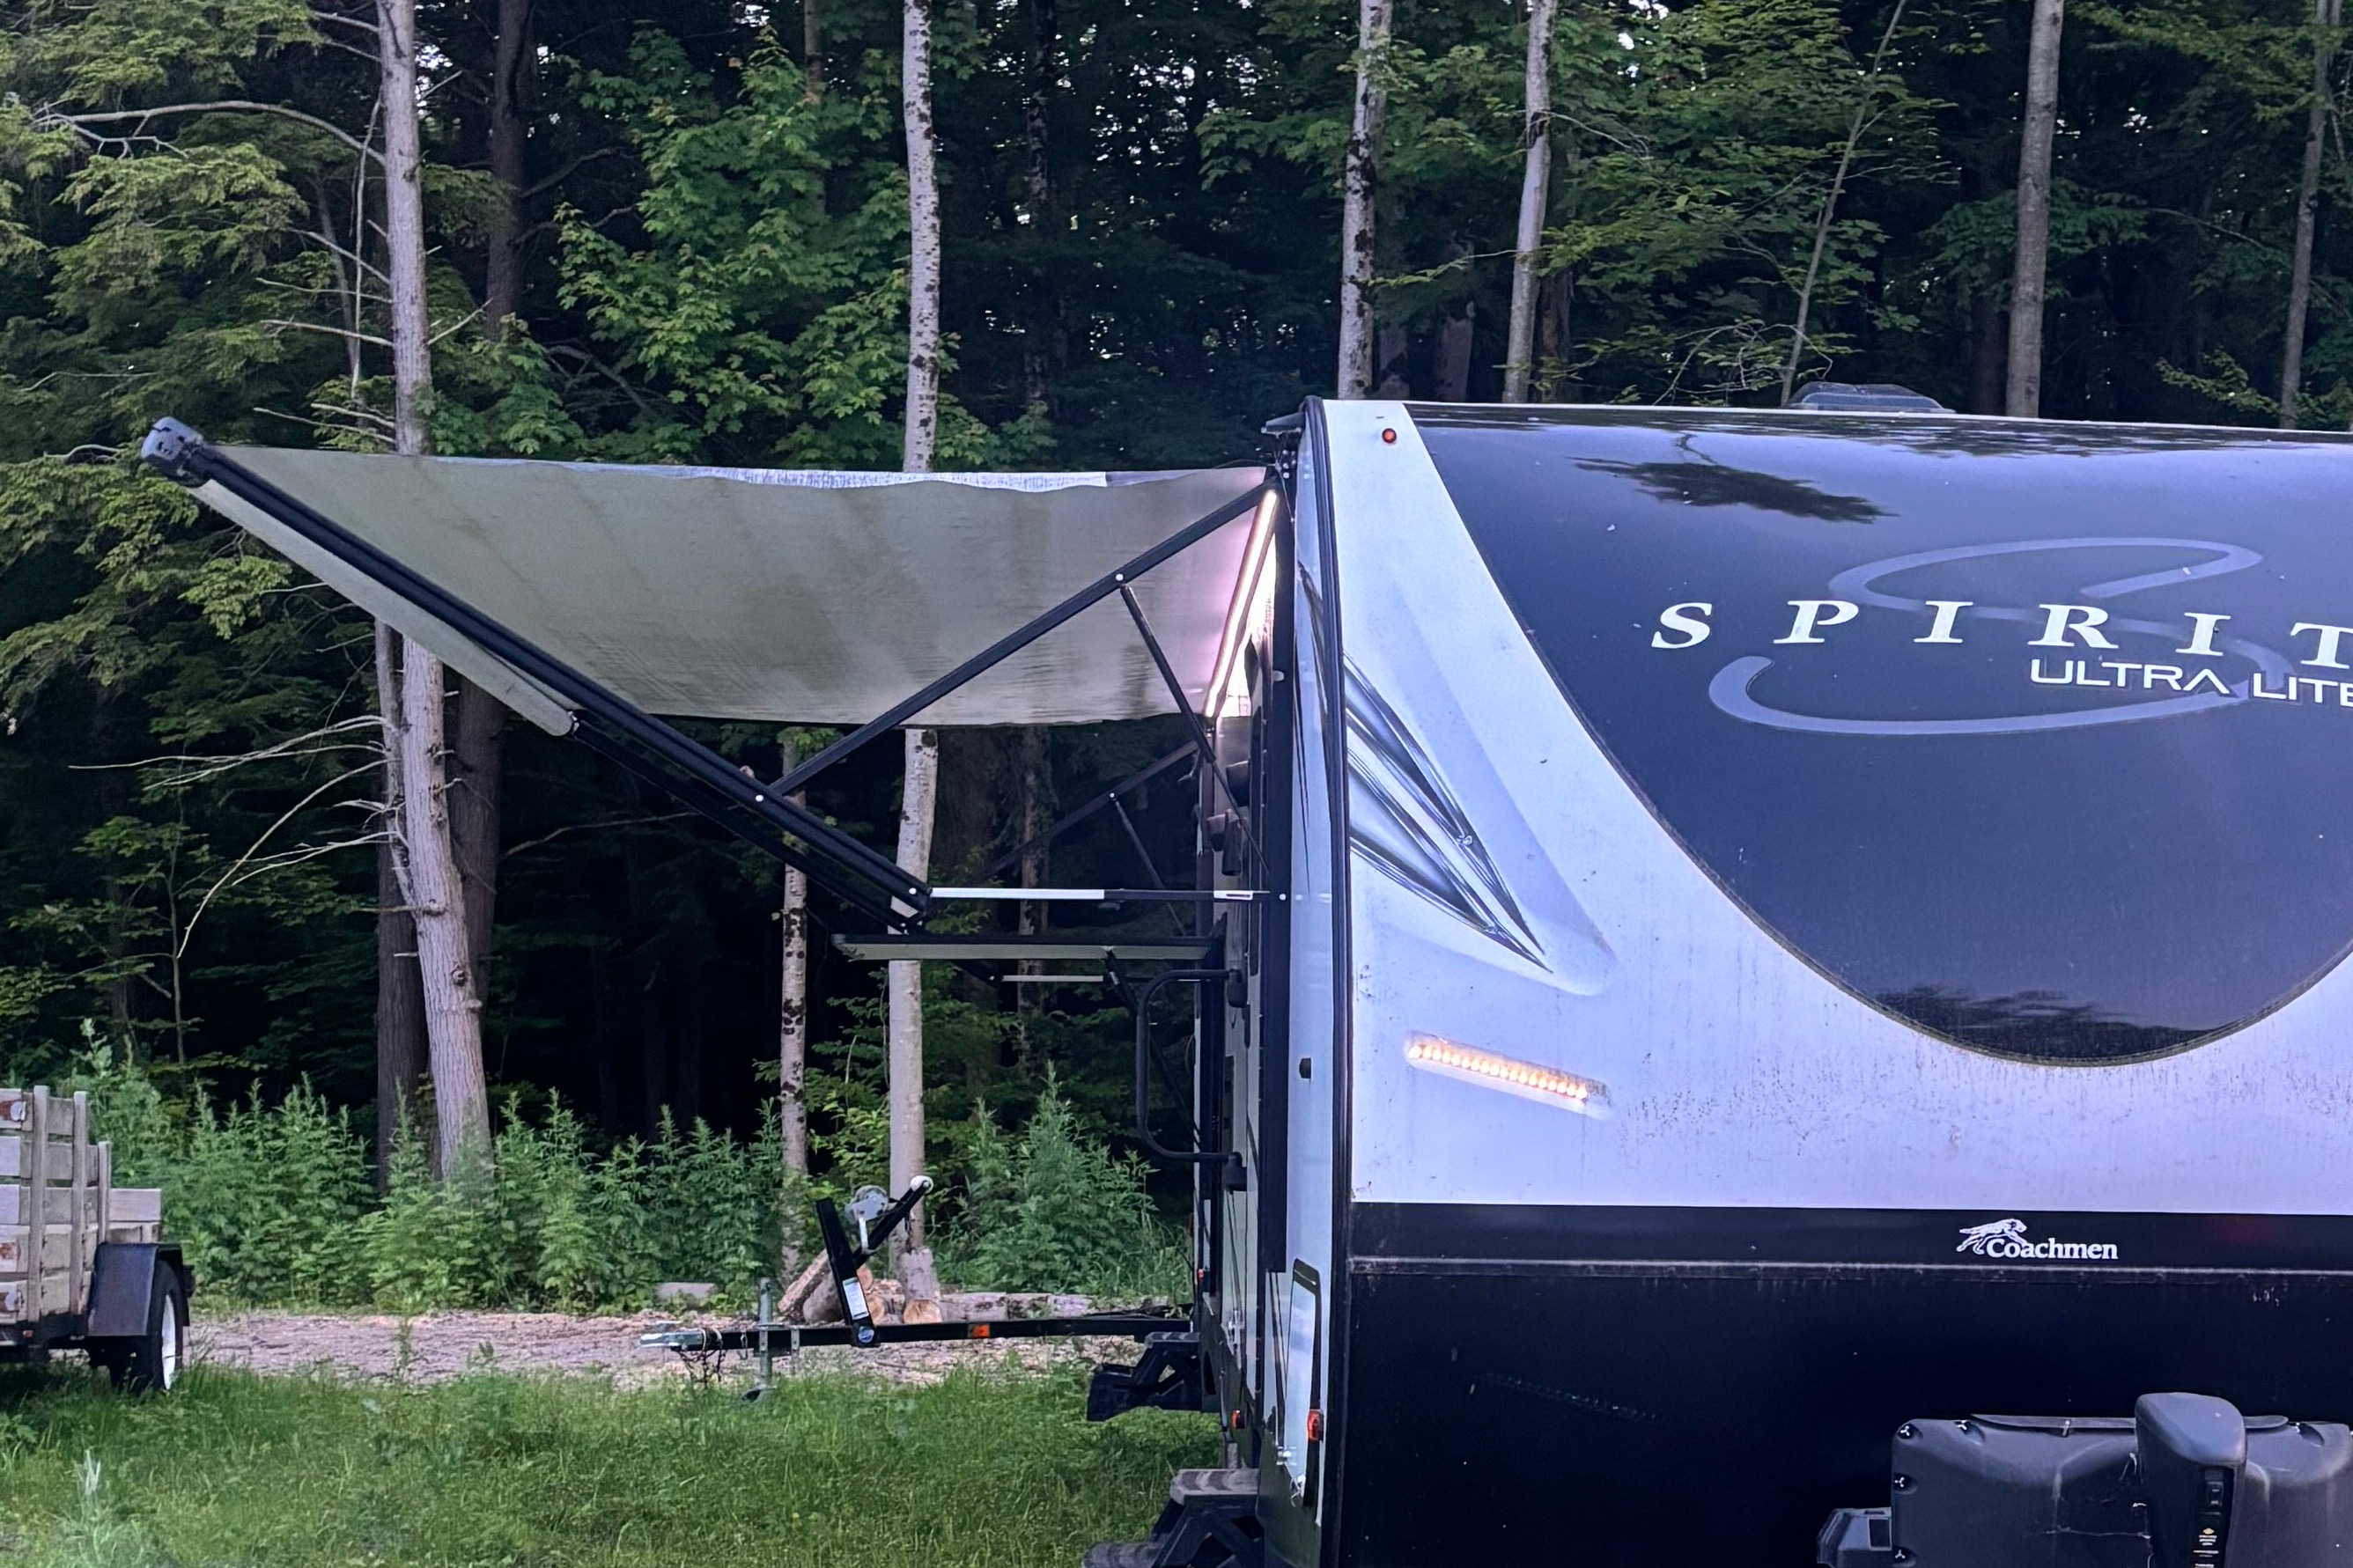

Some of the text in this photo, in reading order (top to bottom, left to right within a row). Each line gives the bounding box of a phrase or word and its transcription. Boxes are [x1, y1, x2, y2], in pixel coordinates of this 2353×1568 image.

[1651, 600, 2353, 669] SPIRIT
[2031, 659, 2231, 695] ULTRA
[1986, 1237, 2119, 1260] Coachmen
